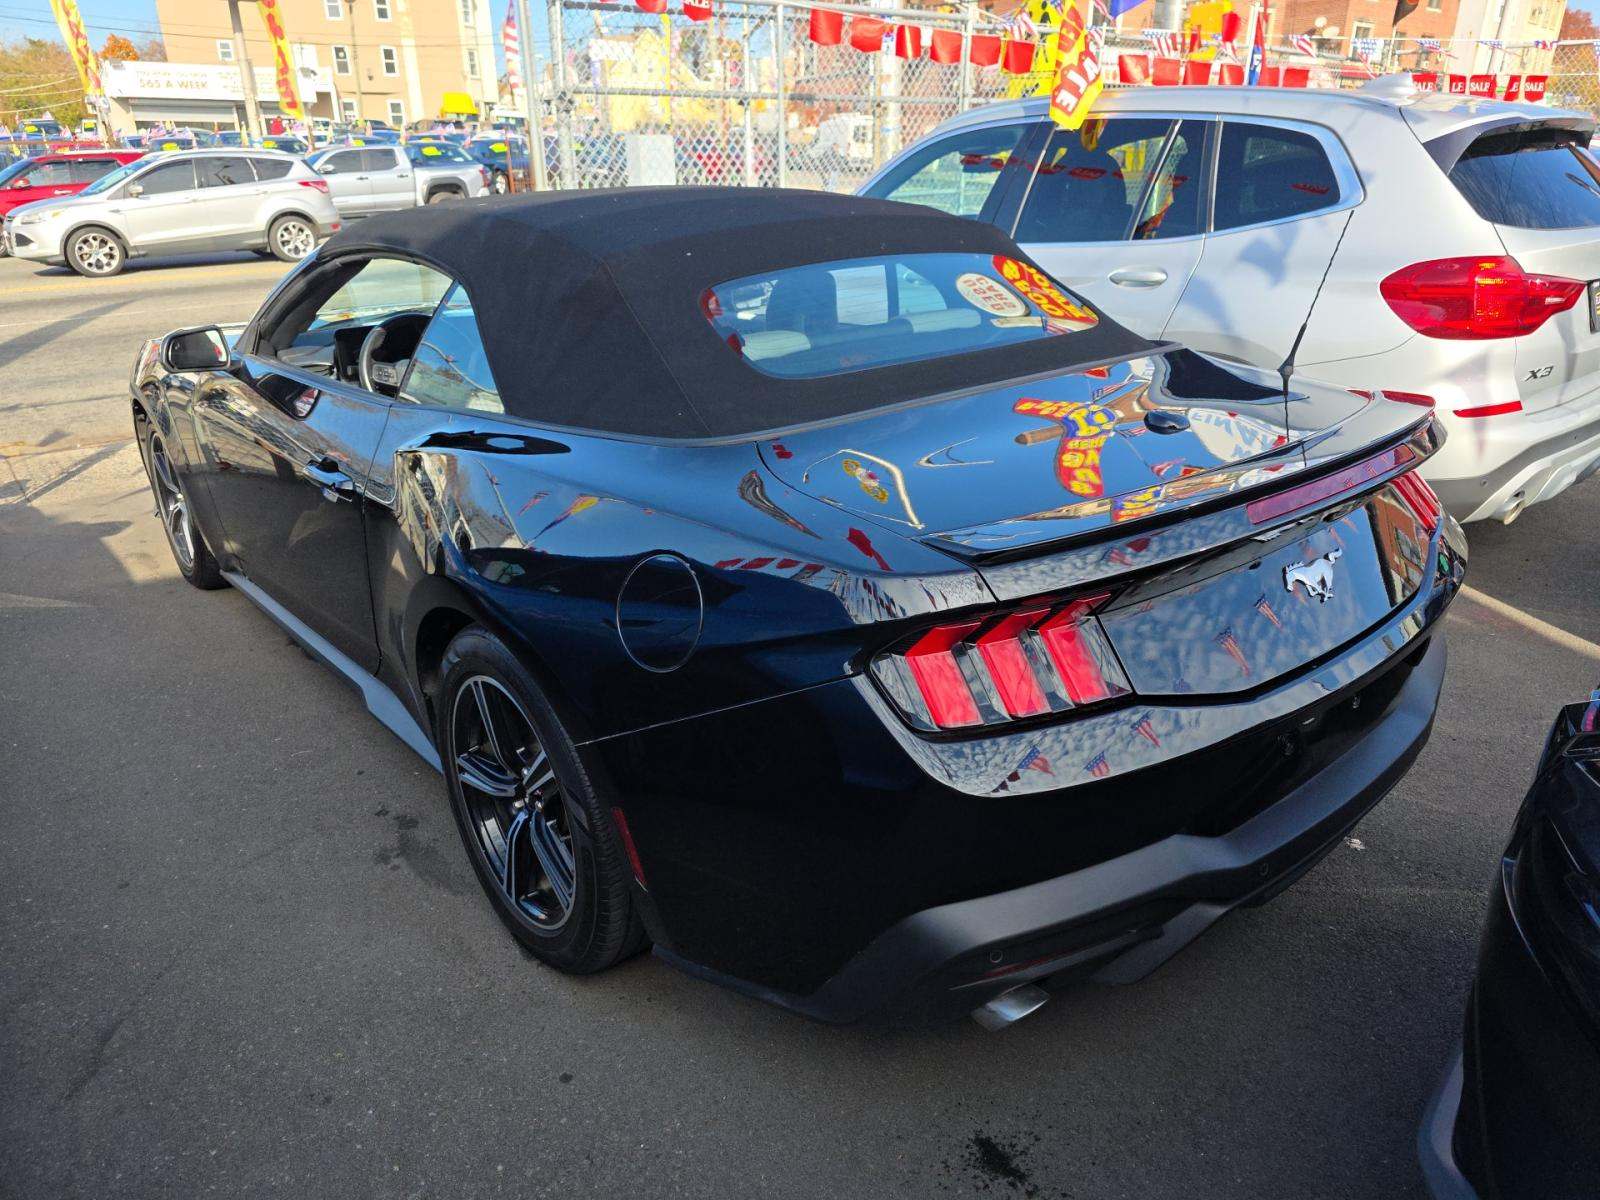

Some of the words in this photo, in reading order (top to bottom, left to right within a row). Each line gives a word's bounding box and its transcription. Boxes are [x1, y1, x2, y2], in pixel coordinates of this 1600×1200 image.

[177, 80, 208, 89] WEEK
[1470, 82, 1491, 92] SALE
[1525, 82, 1544, 92] SALE
[1525, 366, 1554, 381] X3
